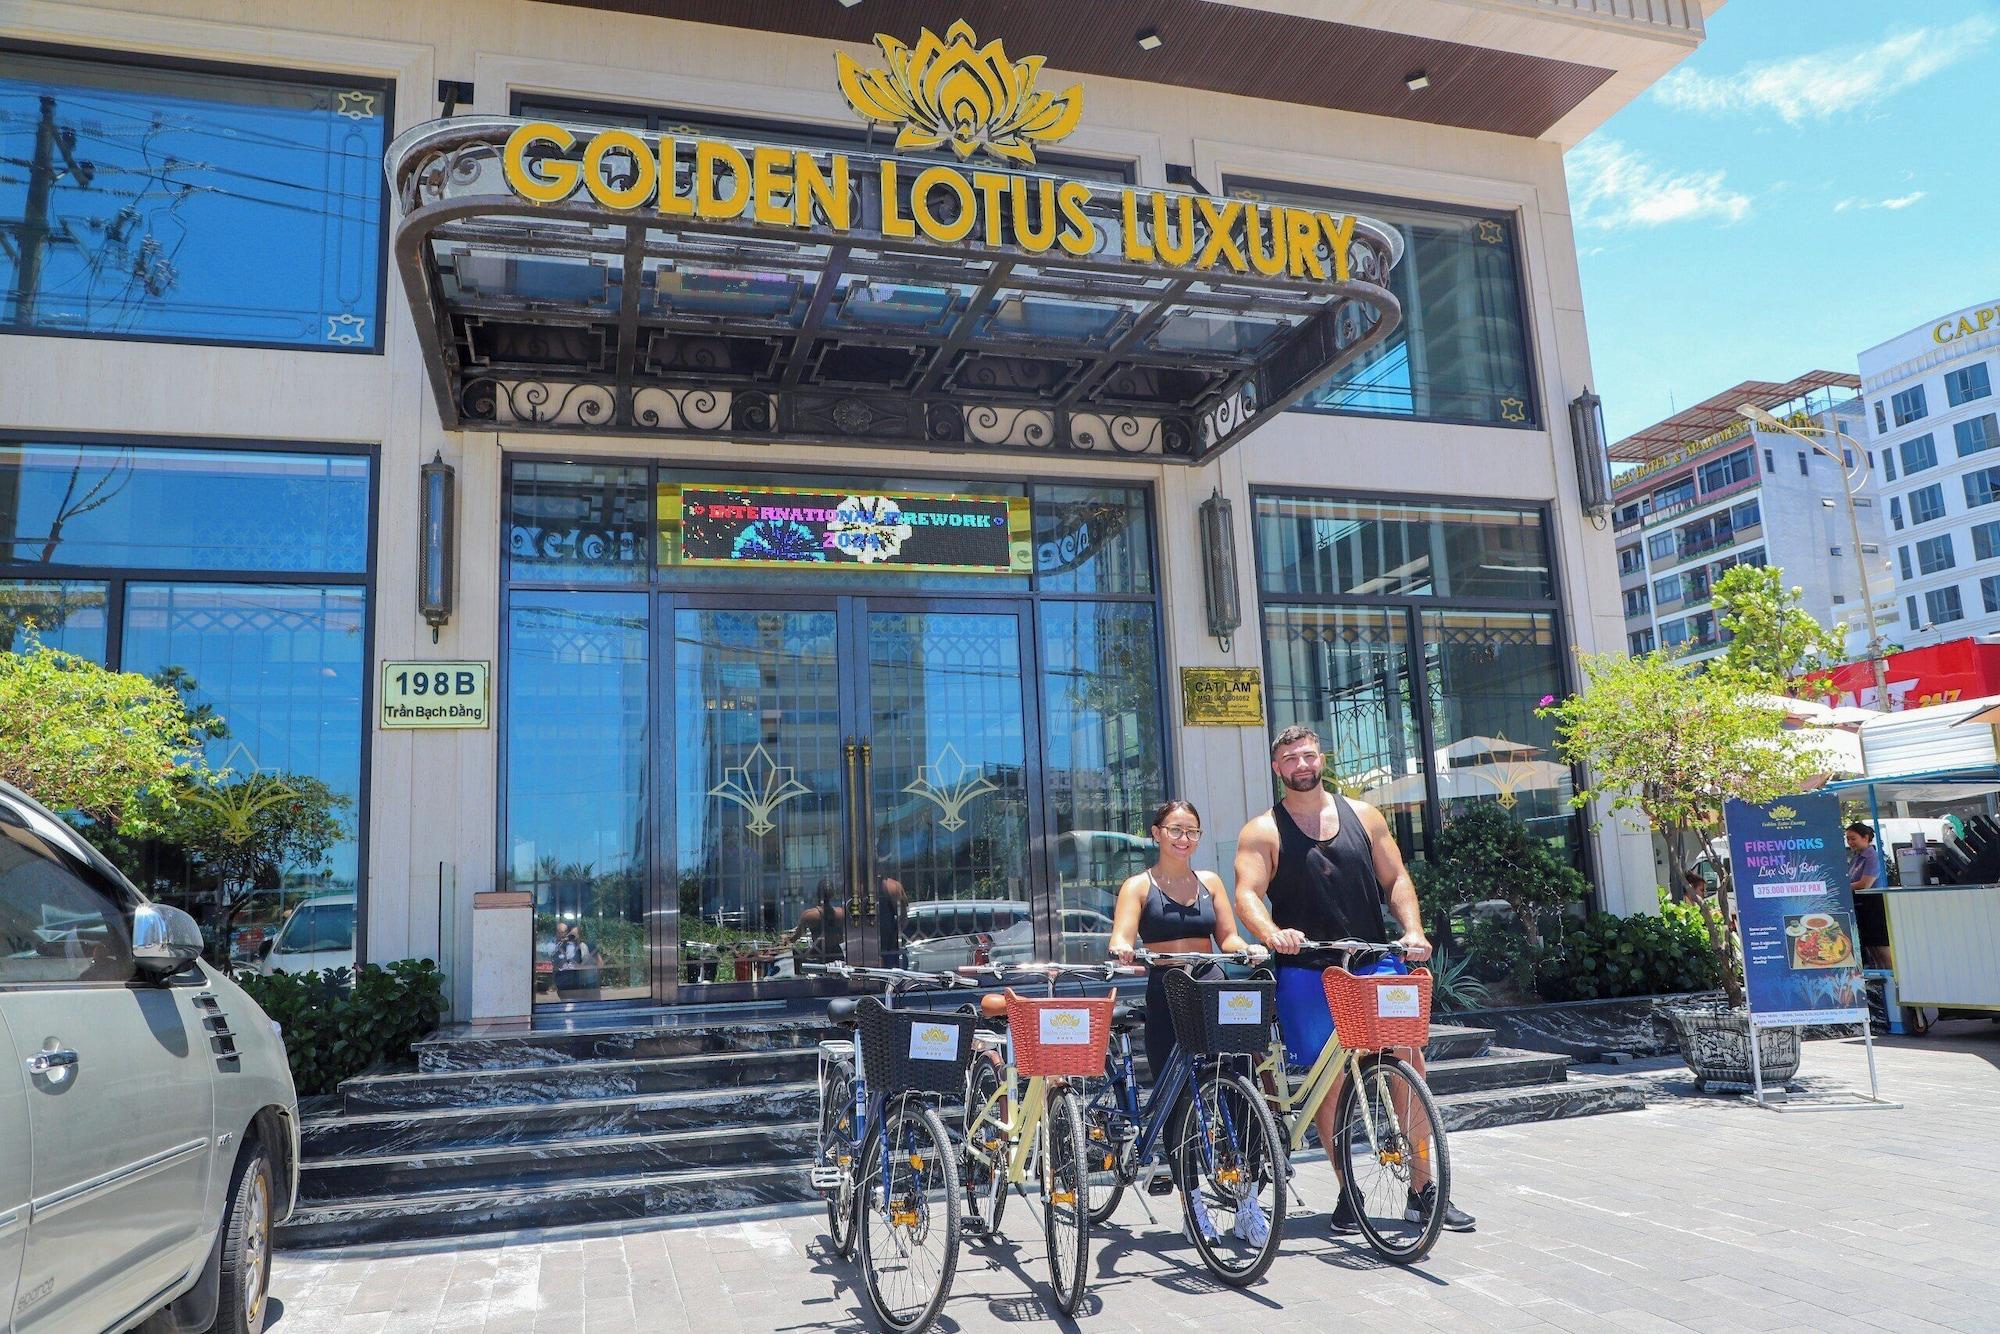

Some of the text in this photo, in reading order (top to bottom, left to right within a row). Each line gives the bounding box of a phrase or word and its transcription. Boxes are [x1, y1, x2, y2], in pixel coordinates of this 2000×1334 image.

[504, 121, 1358, 283] GOLDEN LOTUS LUXURY
[1933, 305, 2000, 344] CAP
[1636, 454, 1669, 478] HOTEL
[823, 531, 881, 550] 2024
[396, 671, 475, 696] 198B
[1919, 688, 1962, 709] 24/7
[385, 703, 414, 718] Trần
[415, 705, 447, 720] Bạch
[1744, 837, 1825, 853] FIREWORKS
[1746, 855, 1786, 868] NIGHT
[1758, 862, 1820, 880] Lux Sky Bar
